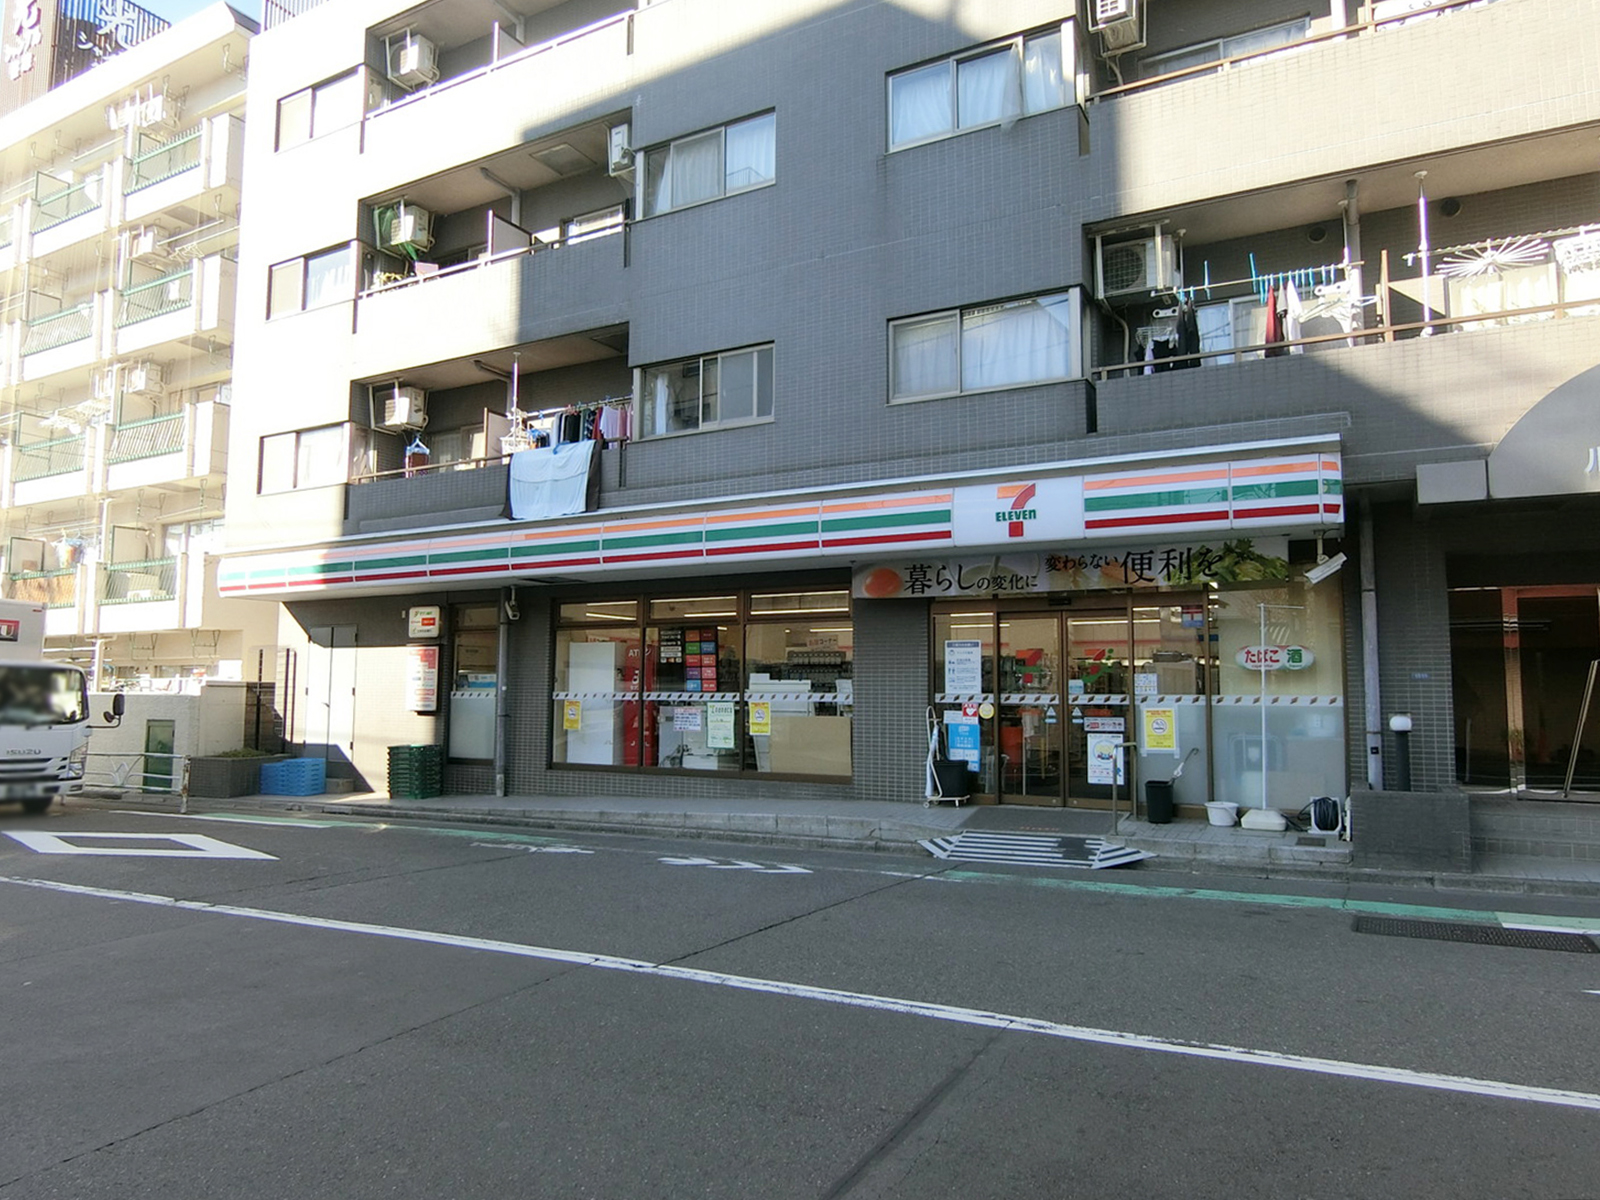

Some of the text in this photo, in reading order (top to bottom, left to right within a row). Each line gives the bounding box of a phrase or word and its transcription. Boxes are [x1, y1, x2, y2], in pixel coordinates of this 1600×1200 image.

[903, 546, 1223, 595] 暮らしの変化に 変わらない便利を
[1244, 648, 1303, 664] たばこ 酒
